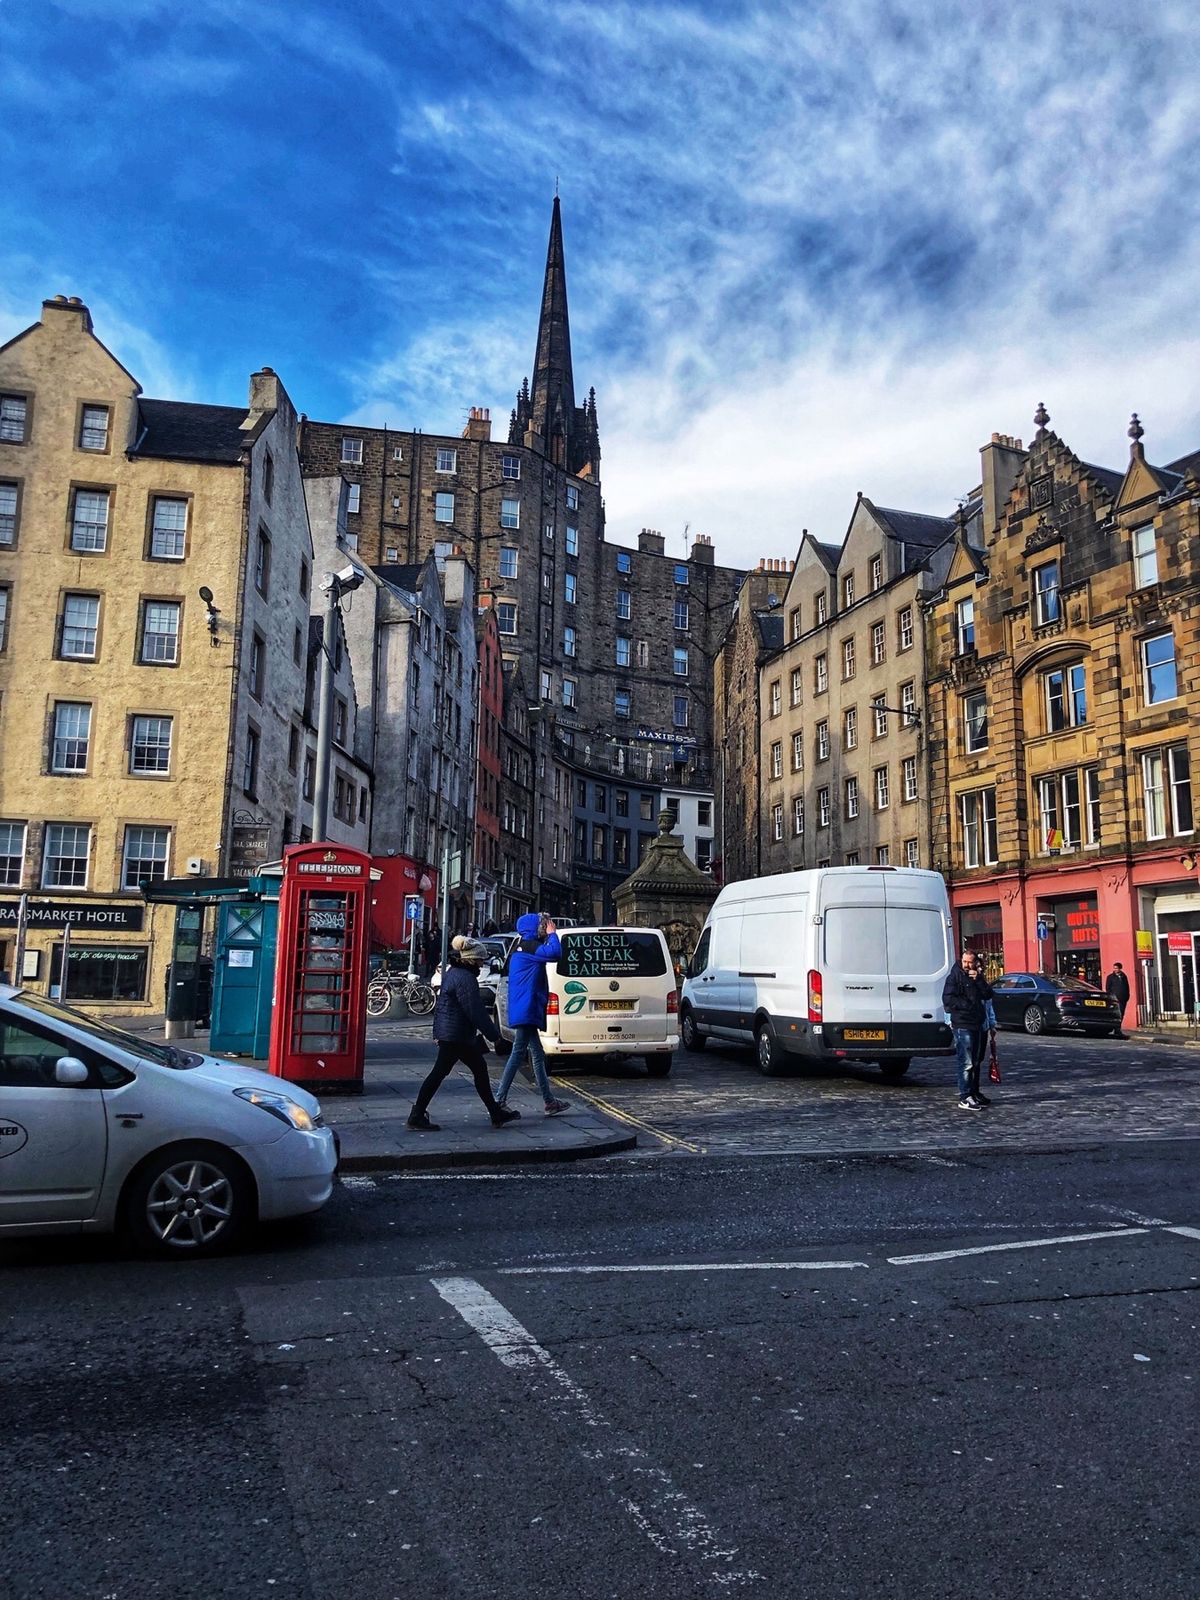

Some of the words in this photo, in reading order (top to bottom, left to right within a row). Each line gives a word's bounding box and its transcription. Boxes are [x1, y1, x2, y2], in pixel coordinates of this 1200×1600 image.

[300, 864, 360, 874] TELEPHONE
[86, 911, 128, 923] HOTEL
[567, 935, 630, 948] MUSSEL
[1072, 927, 1098, 943] NUTS
[567, 949, 580, 962] &
[584, 949, 635, 961] STEAK
[569, 962, 601, 976] BAR
[848, 1030, 864, 1038] SH16
[865, 1030, 880, 1038] RZK
